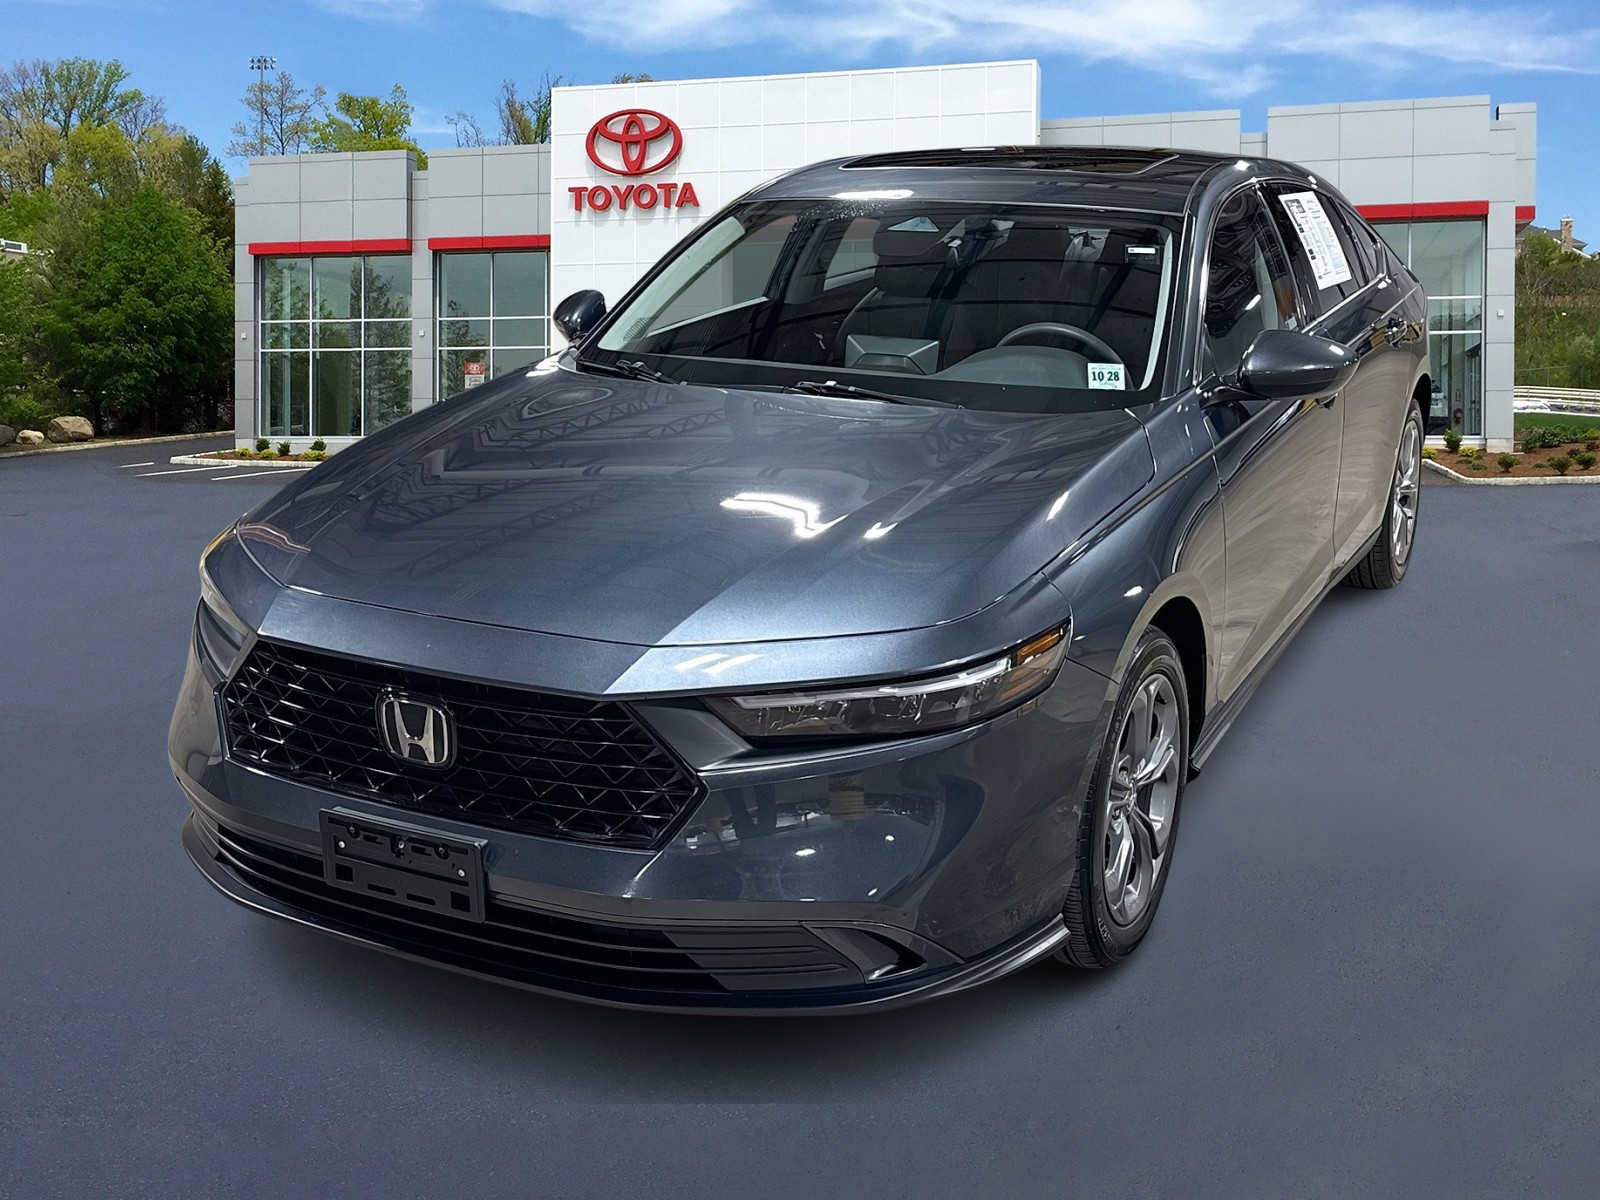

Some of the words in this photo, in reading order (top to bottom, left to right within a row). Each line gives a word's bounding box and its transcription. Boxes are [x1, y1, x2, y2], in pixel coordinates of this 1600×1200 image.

[568, 182, 700, 212] TOYOTA
[1092, 371, 1104, 382] 10
[1107, 371, 1120, 382] 28
